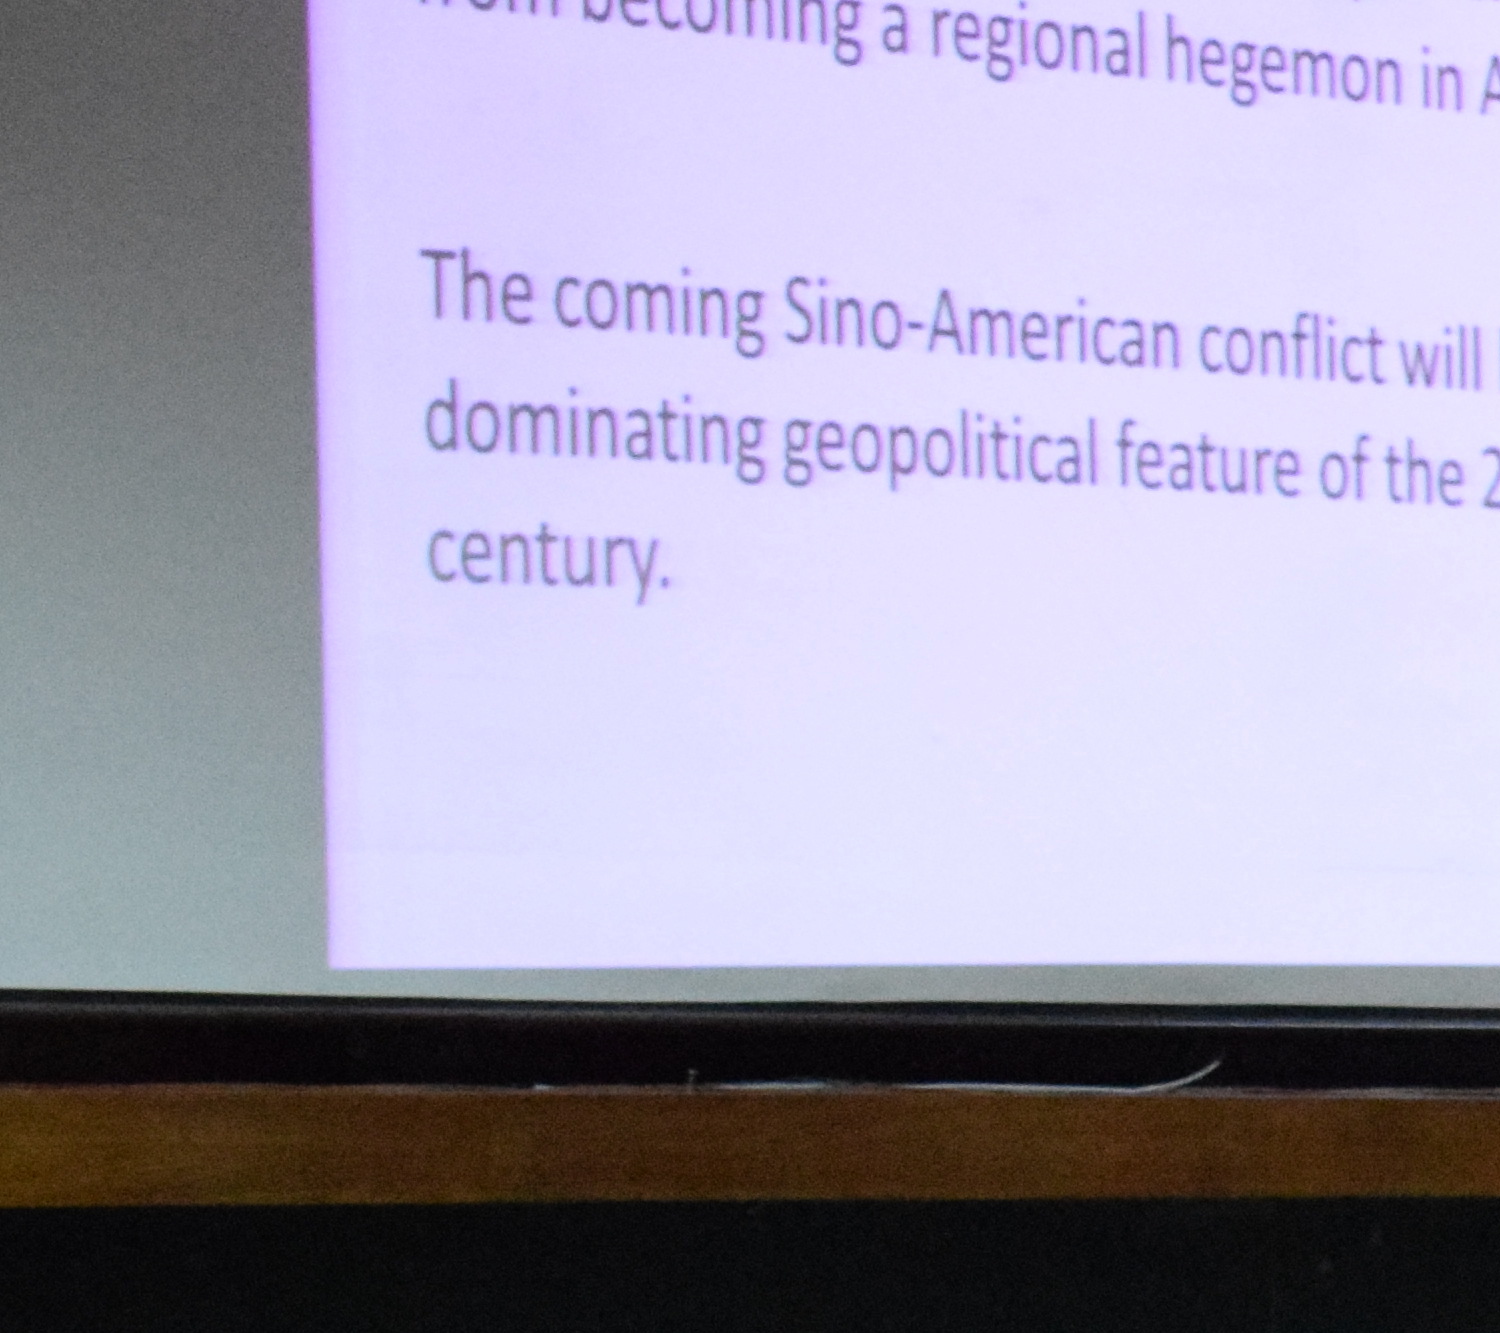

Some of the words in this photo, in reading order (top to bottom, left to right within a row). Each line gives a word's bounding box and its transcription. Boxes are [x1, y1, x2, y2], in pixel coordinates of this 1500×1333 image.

[881, 2, 911, 55] a
[931, 1, 1149, 84] regional
[1164, 12, 1403, 108] hegemon
[1420, 44, 1465, 112] in
[418, 245, 536, 326] The
[552, 265, 768, 360] coming
[783, 274, 1181, 369] Sino-American
[1197, 309, 1388, 386] conflict
[1396, 324, 1483, 393] will
[423, 376, 768, 485] dominating
[781, 407, 1100, 492] geopolitical
[1115, 417, 1303, 498] feature
[1317, 432, 1372, 502] of
[1383, 437, 1466, 508] the
[426, 521, 671, 607] century.
